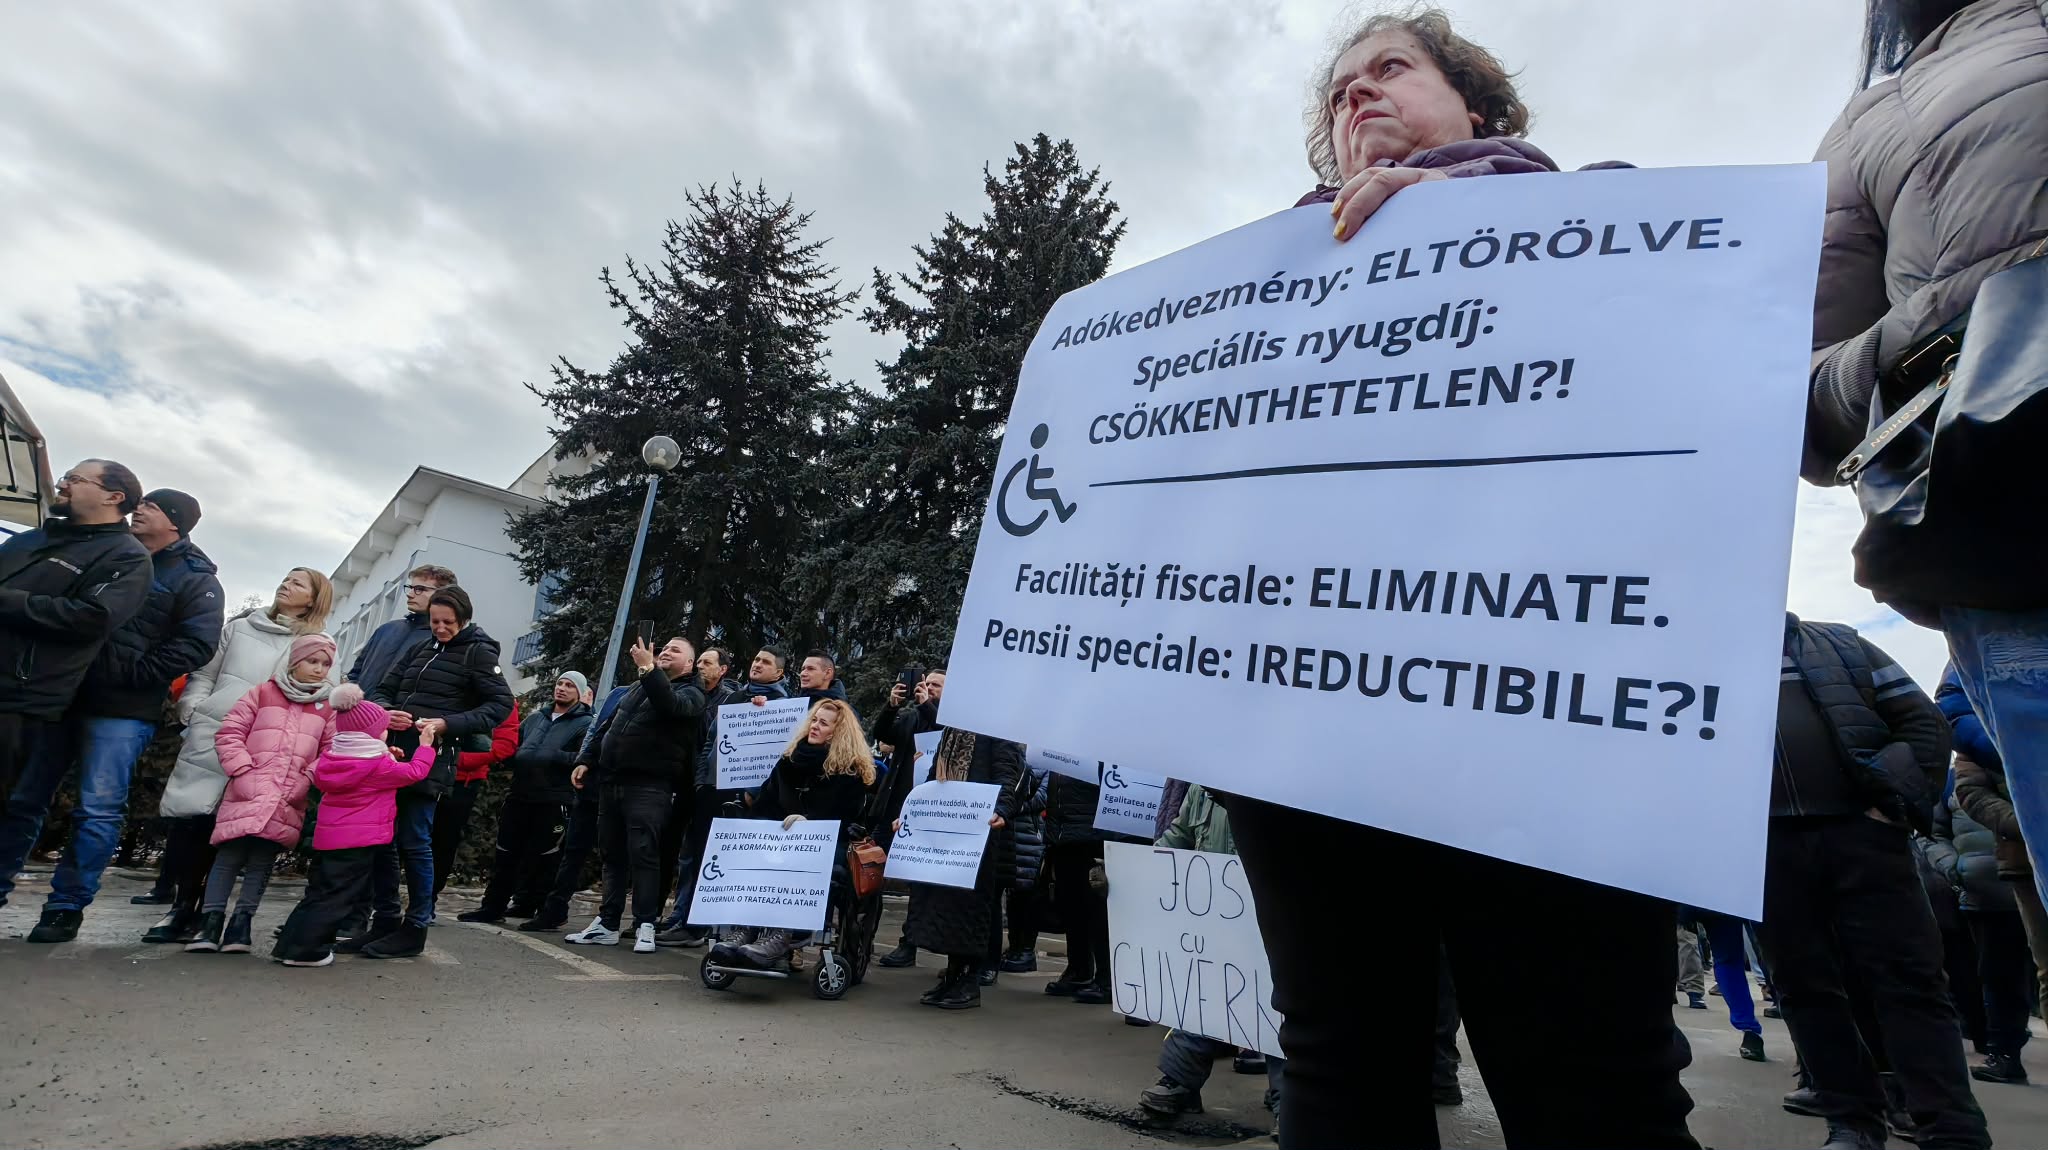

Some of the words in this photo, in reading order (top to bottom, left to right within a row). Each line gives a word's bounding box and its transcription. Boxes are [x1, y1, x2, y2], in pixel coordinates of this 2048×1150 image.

[1052, 266, 1354, 351] Adókedvezmény:
[1366, 217, 1742, 285] ELTÖRÖLVE.
[1133, 331, 1287, 392] Speciális
[1295, 298, 1499, 364] nyugdíj:
[1088, 358, 1575, 444] CSÖKKENTHETETLEN?!
[1015, 562, 1147, 607] Facilități
[1155, 563, 1295, 607] fiscale:
[1308, 567, 1670, 629] ELIMINATE.
[983, 619, 1072, 658] Pensii
[1076, 633, 1233, 679] speciale:
[1245, 643, 1721, 741] IREDUCTIBILE?!
[738, 712, 748, 720] egy
[730, 774, 760, 783] persoanele
[969, 801, 986, 809] ahol
[1104, 793, 1145, 808] Egalitatea
[1146, 801, 1157, 810] de
[1101, 806, 1121, 816] gest,
[1123, 807, 1132, 816] ci
[1132, 811, 1143, 819] un
[758, 833, 783, 842] LENNI
[784, 833, 803, 841] NEM
[803, 833, 832, 842] LUXUS,
[721, 843, 731, 851] DE
[731, 843, 738, 851] A
[794, 844, 822, 853] KEZELI
[891, 842, 909, 850] Statul
[1153, 849, 1245, 919] JOS
[698, 885, 746, 893] DIZABILITATEA
[746, 885, 757, 893] NU
[758, 885, 776, 893] ESTE
[777, 886, 790, 895] UN
[809, 888, 825, 897] DAR
[701, 895, 736, 904] GUVERNUL
[736, 895, 743, 903] O
[782, 897, 793, 906] CA
[793, 898, 818, 907] ATARE
